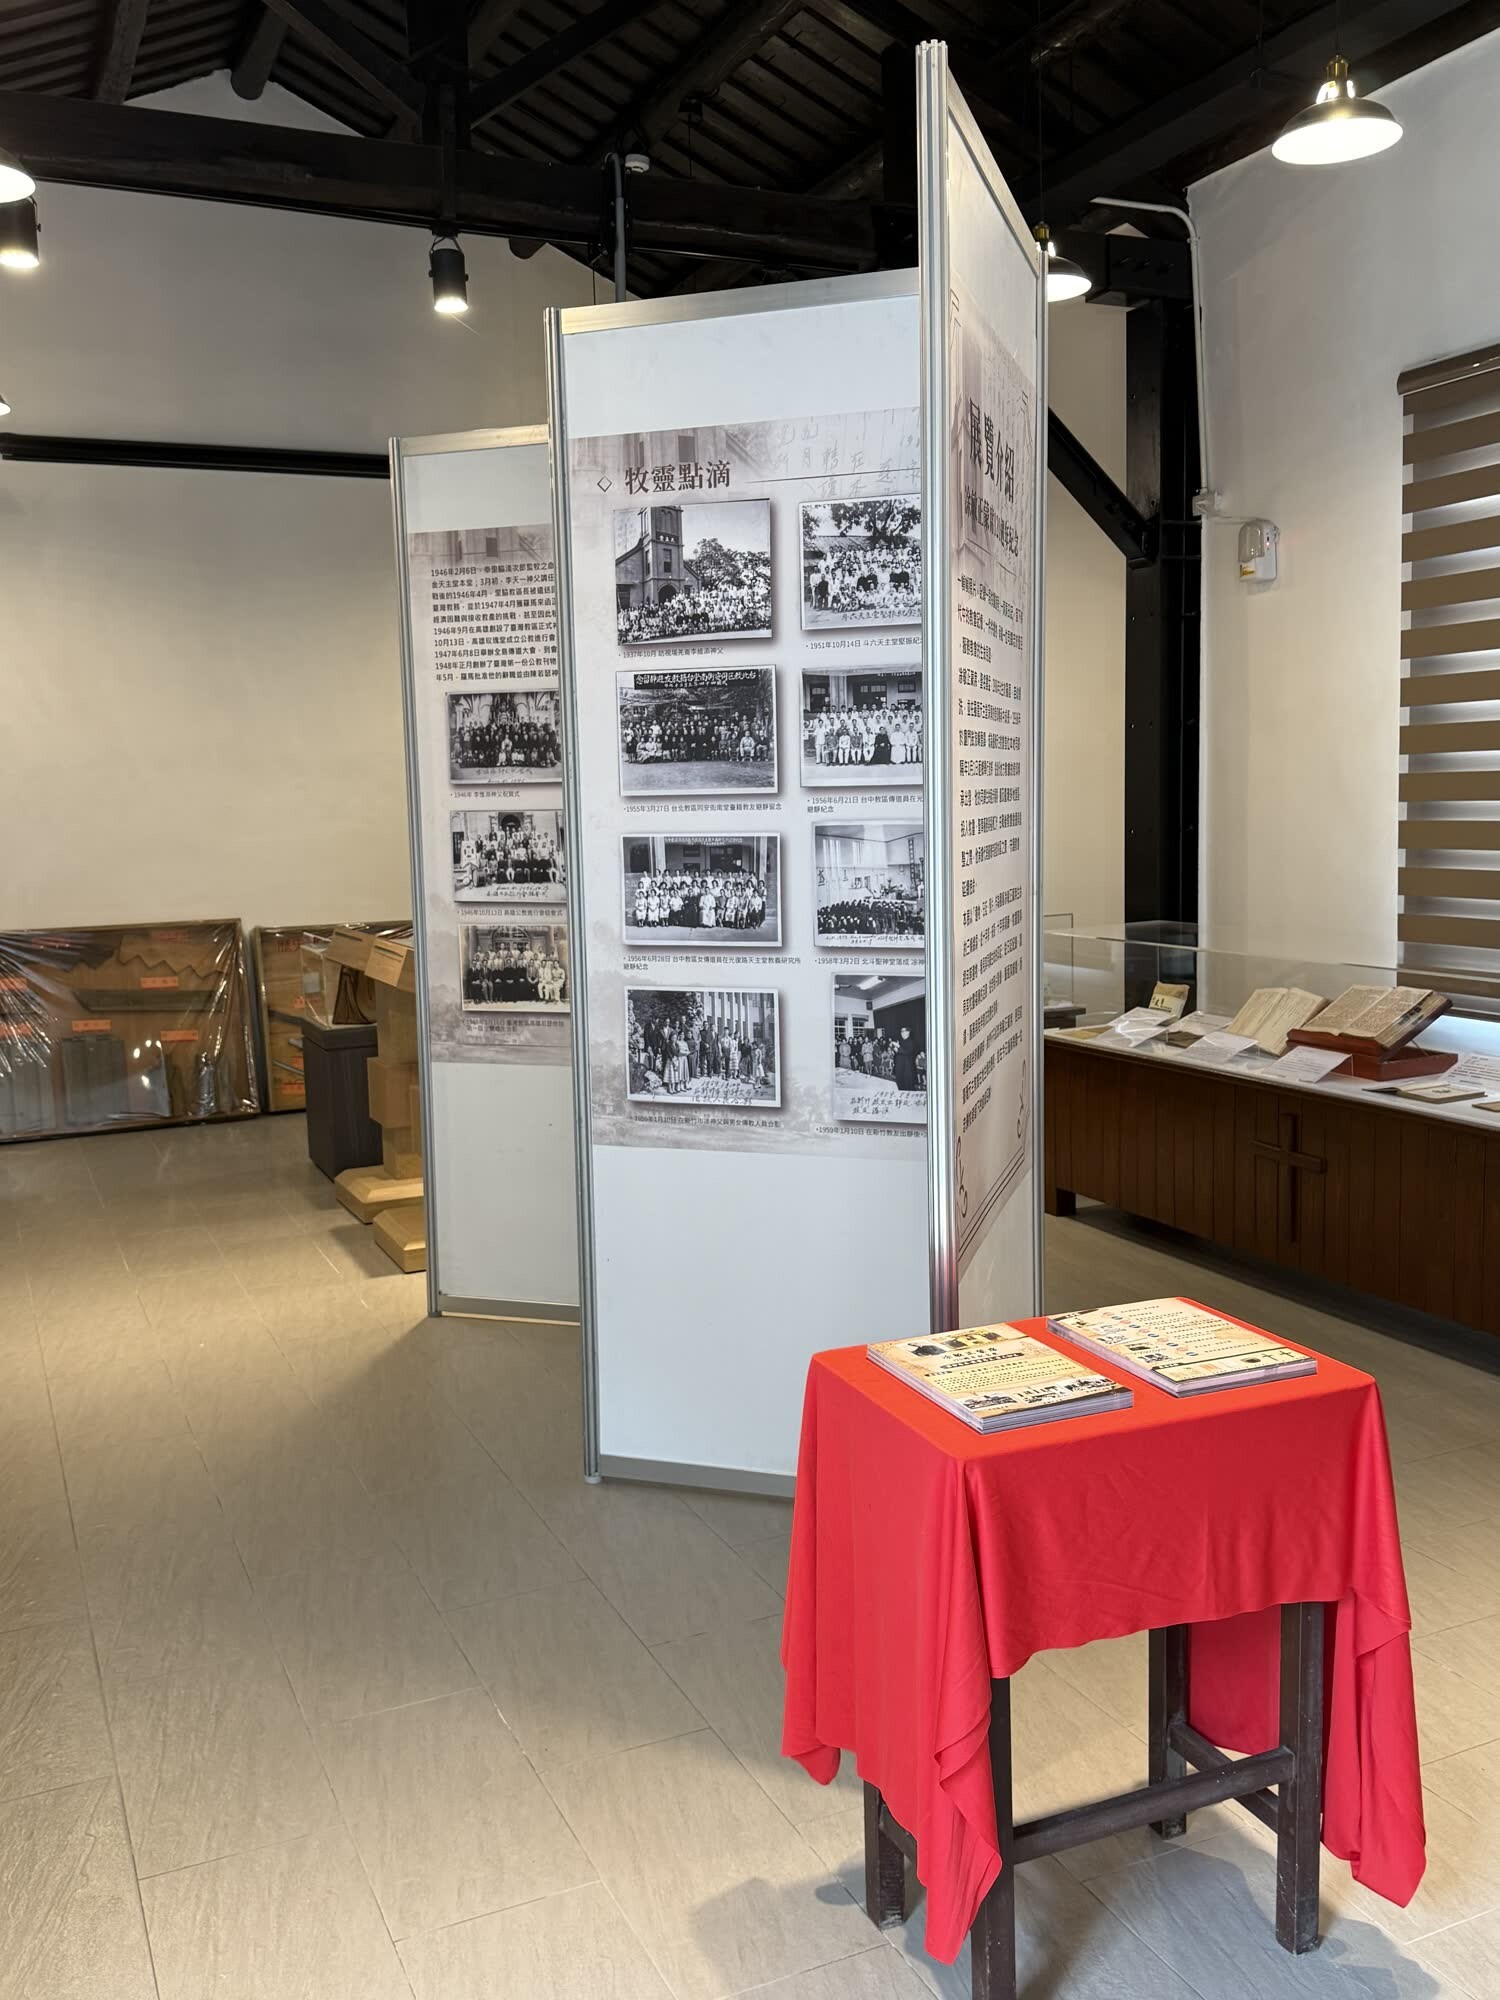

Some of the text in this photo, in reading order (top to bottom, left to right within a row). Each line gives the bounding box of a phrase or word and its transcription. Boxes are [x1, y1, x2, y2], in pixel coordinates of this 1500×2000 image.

[969, 398, 1015, 503] 展覽介紹
[624, 460, 731, 495] 牧靈點滴
[863, 637, 922, 646] 斗六天主堂堅振紀
